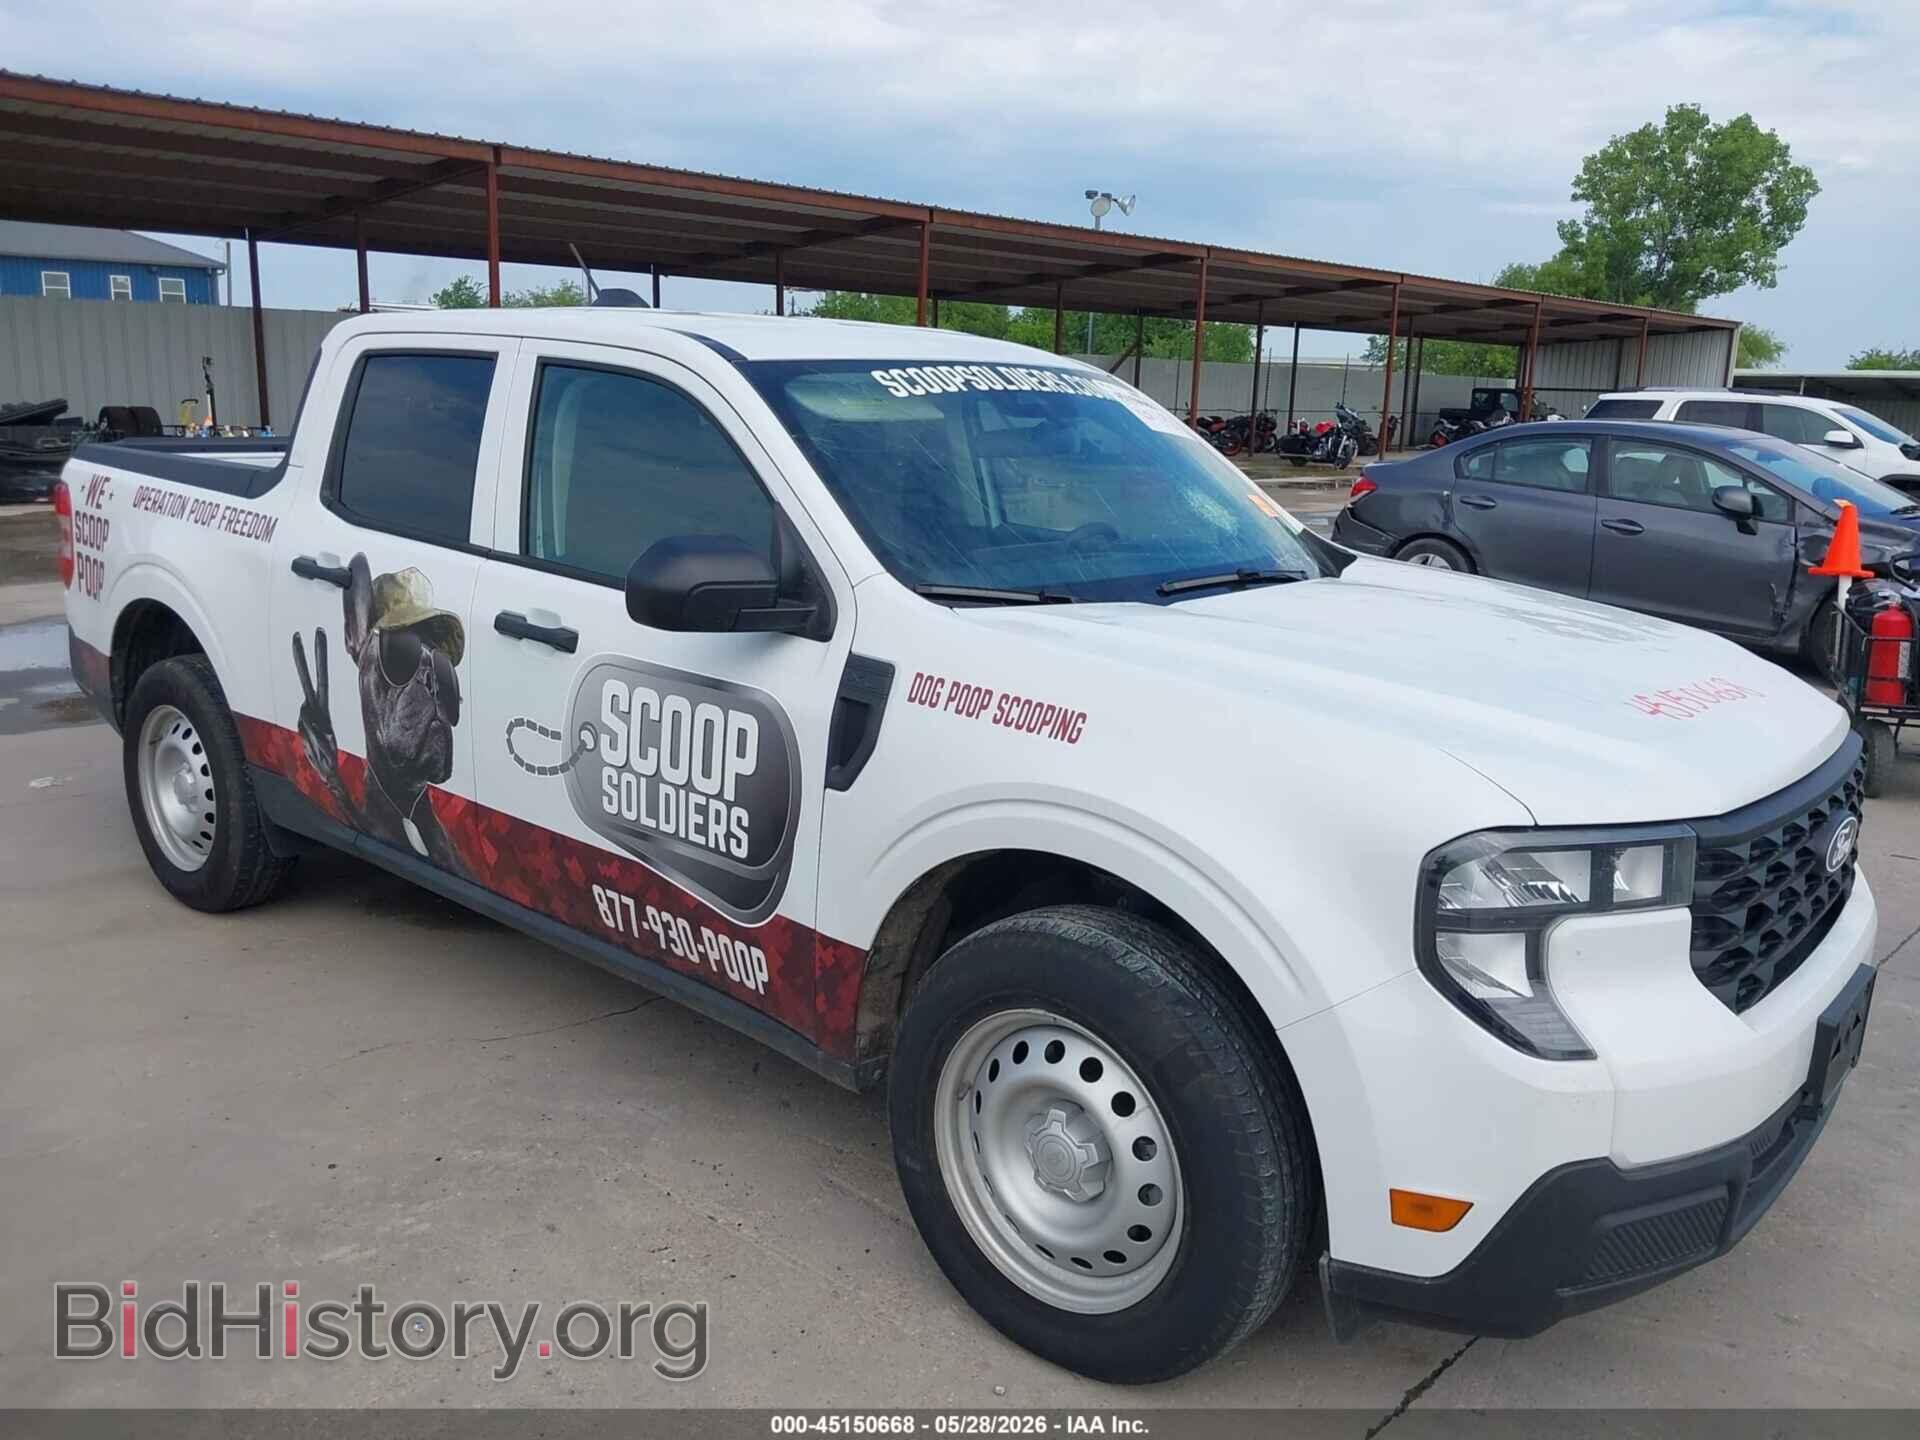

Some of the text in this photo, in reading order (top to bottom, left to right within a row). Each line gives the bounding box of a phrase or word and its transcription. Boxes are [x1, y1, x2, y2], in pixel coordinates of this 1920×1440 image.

[84, 473, 112, 510] WE
[131, 484, 280, 545] OPERATION POOP FREEDOM
[74, 509, 110, 553] SCOOP
[76, 550, 105, 603] POOP
[599, 678, 760, 802] SCOOP
[906, 671, 1088, 745] DOG POOP SCOOPING
[601, 765, 750, 860] SOLDIERS
[591, 883, 770, 996] 877-930-POOP
